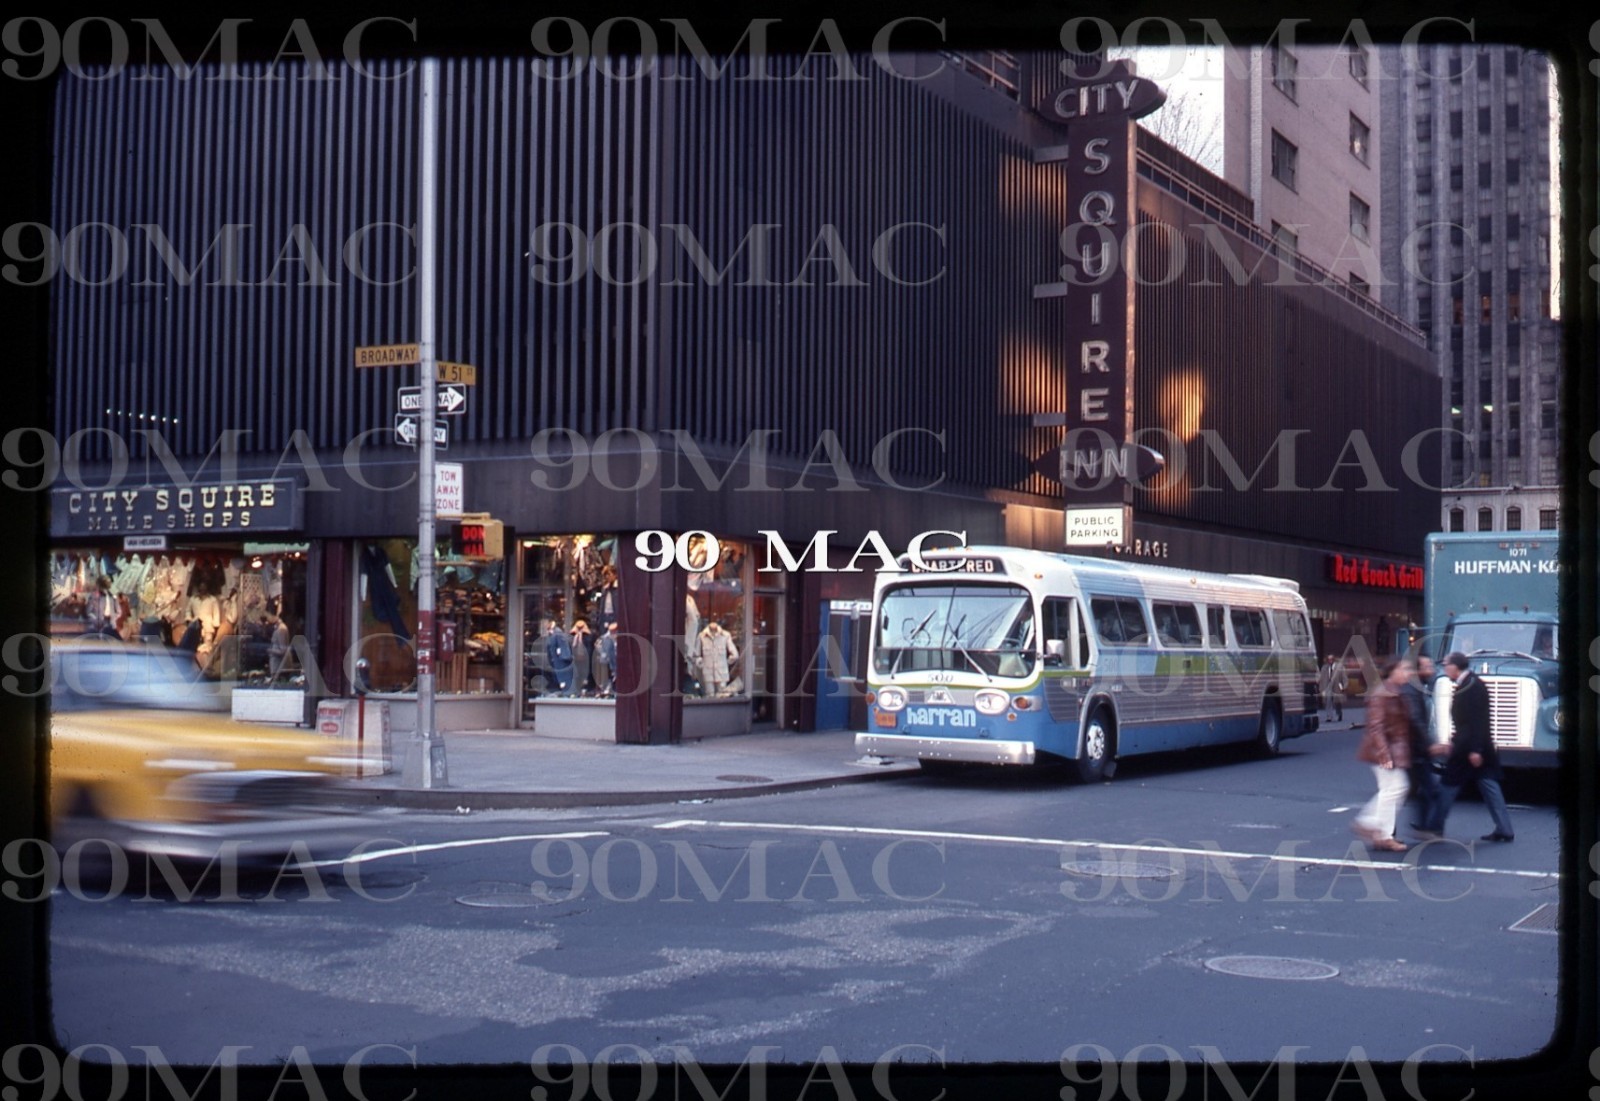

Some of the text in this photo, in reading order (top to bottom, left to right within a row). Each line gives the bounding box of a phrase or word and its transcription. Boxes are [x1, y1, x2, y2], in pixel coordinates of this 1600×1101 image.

[1055, 79, 1139, 118] CITY
[1079, 137, 1117, 421] SQUIRE
[360, 347, 416, 363] BROADWAY
[439, 365, 448, 379] W
[452, 366, 463, 381] 51
[403, 424, 444, 439] ON AY
[1060, 448, 1128, 478] INN
[440, 470, 457, 481] TOW
[69, 484, 275, 513] CITY SQUIRE
[436, 485, 460, 496] AWAY
[436, 500, 460, 510] ZONE
[88, 511, 251, 530] MALE SHOPS
[1074, 516, 1115, 526] PUBLIC
[462, 526, 486, 541] DON
[1070, 528, 1119, 538] PARKING
[1509, 548, 1527, 557] 1071
[1335, 553, 1358, 584] Red
[906, 706, 977, 728] harran
